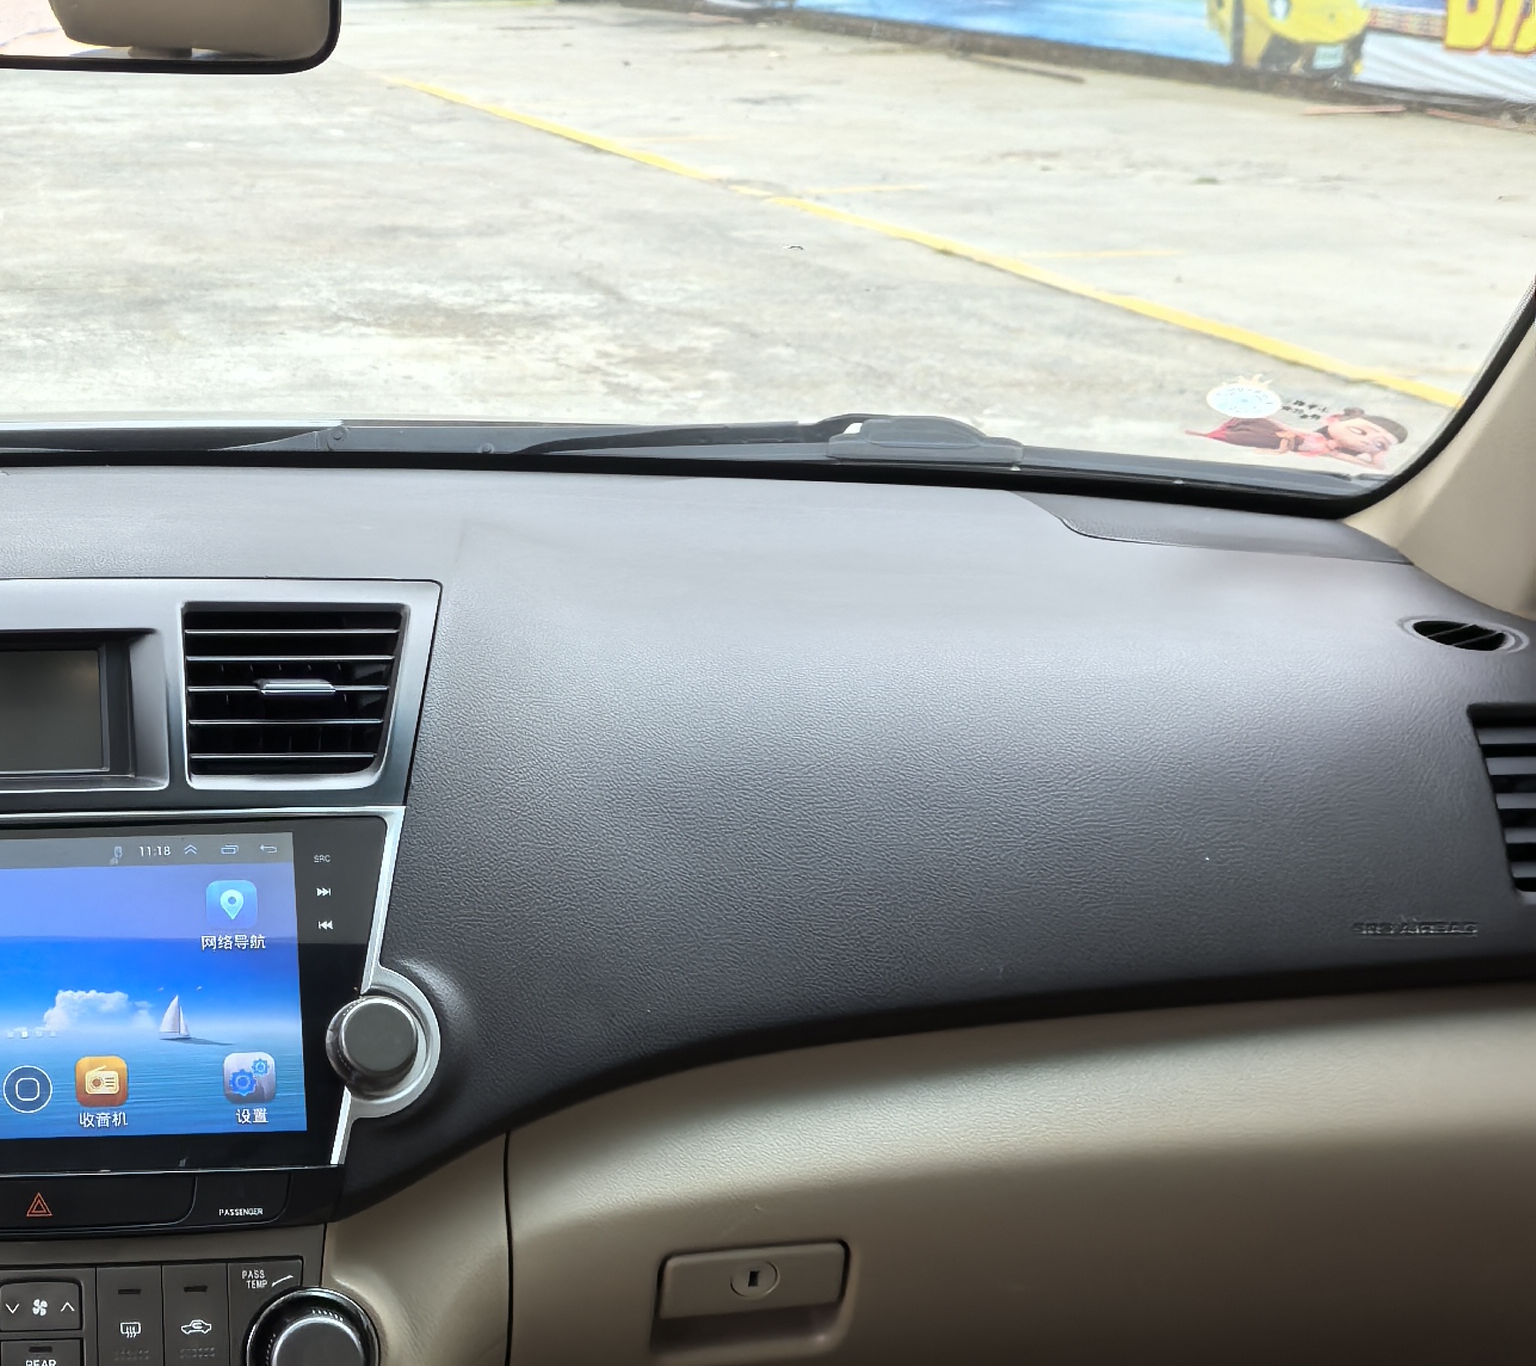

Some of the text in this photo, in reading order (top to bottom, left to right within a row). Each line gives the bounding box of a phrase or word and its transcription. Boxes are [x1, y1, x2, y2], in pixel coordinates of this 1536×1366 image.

[139, 844, 172, 858] 11:18
[314, 854, 332, 864] SRC
[200, 934, 267, 951] 网络导航
[78, 1111, 129, 1129] 收音机
[235, 1108, 270, 1125] 设置
[218, 1206, 264, 1216] PASSENGER
[241, 1269, 265, 1280] PASS
[246, 1280, 268, 1289] TEMP
